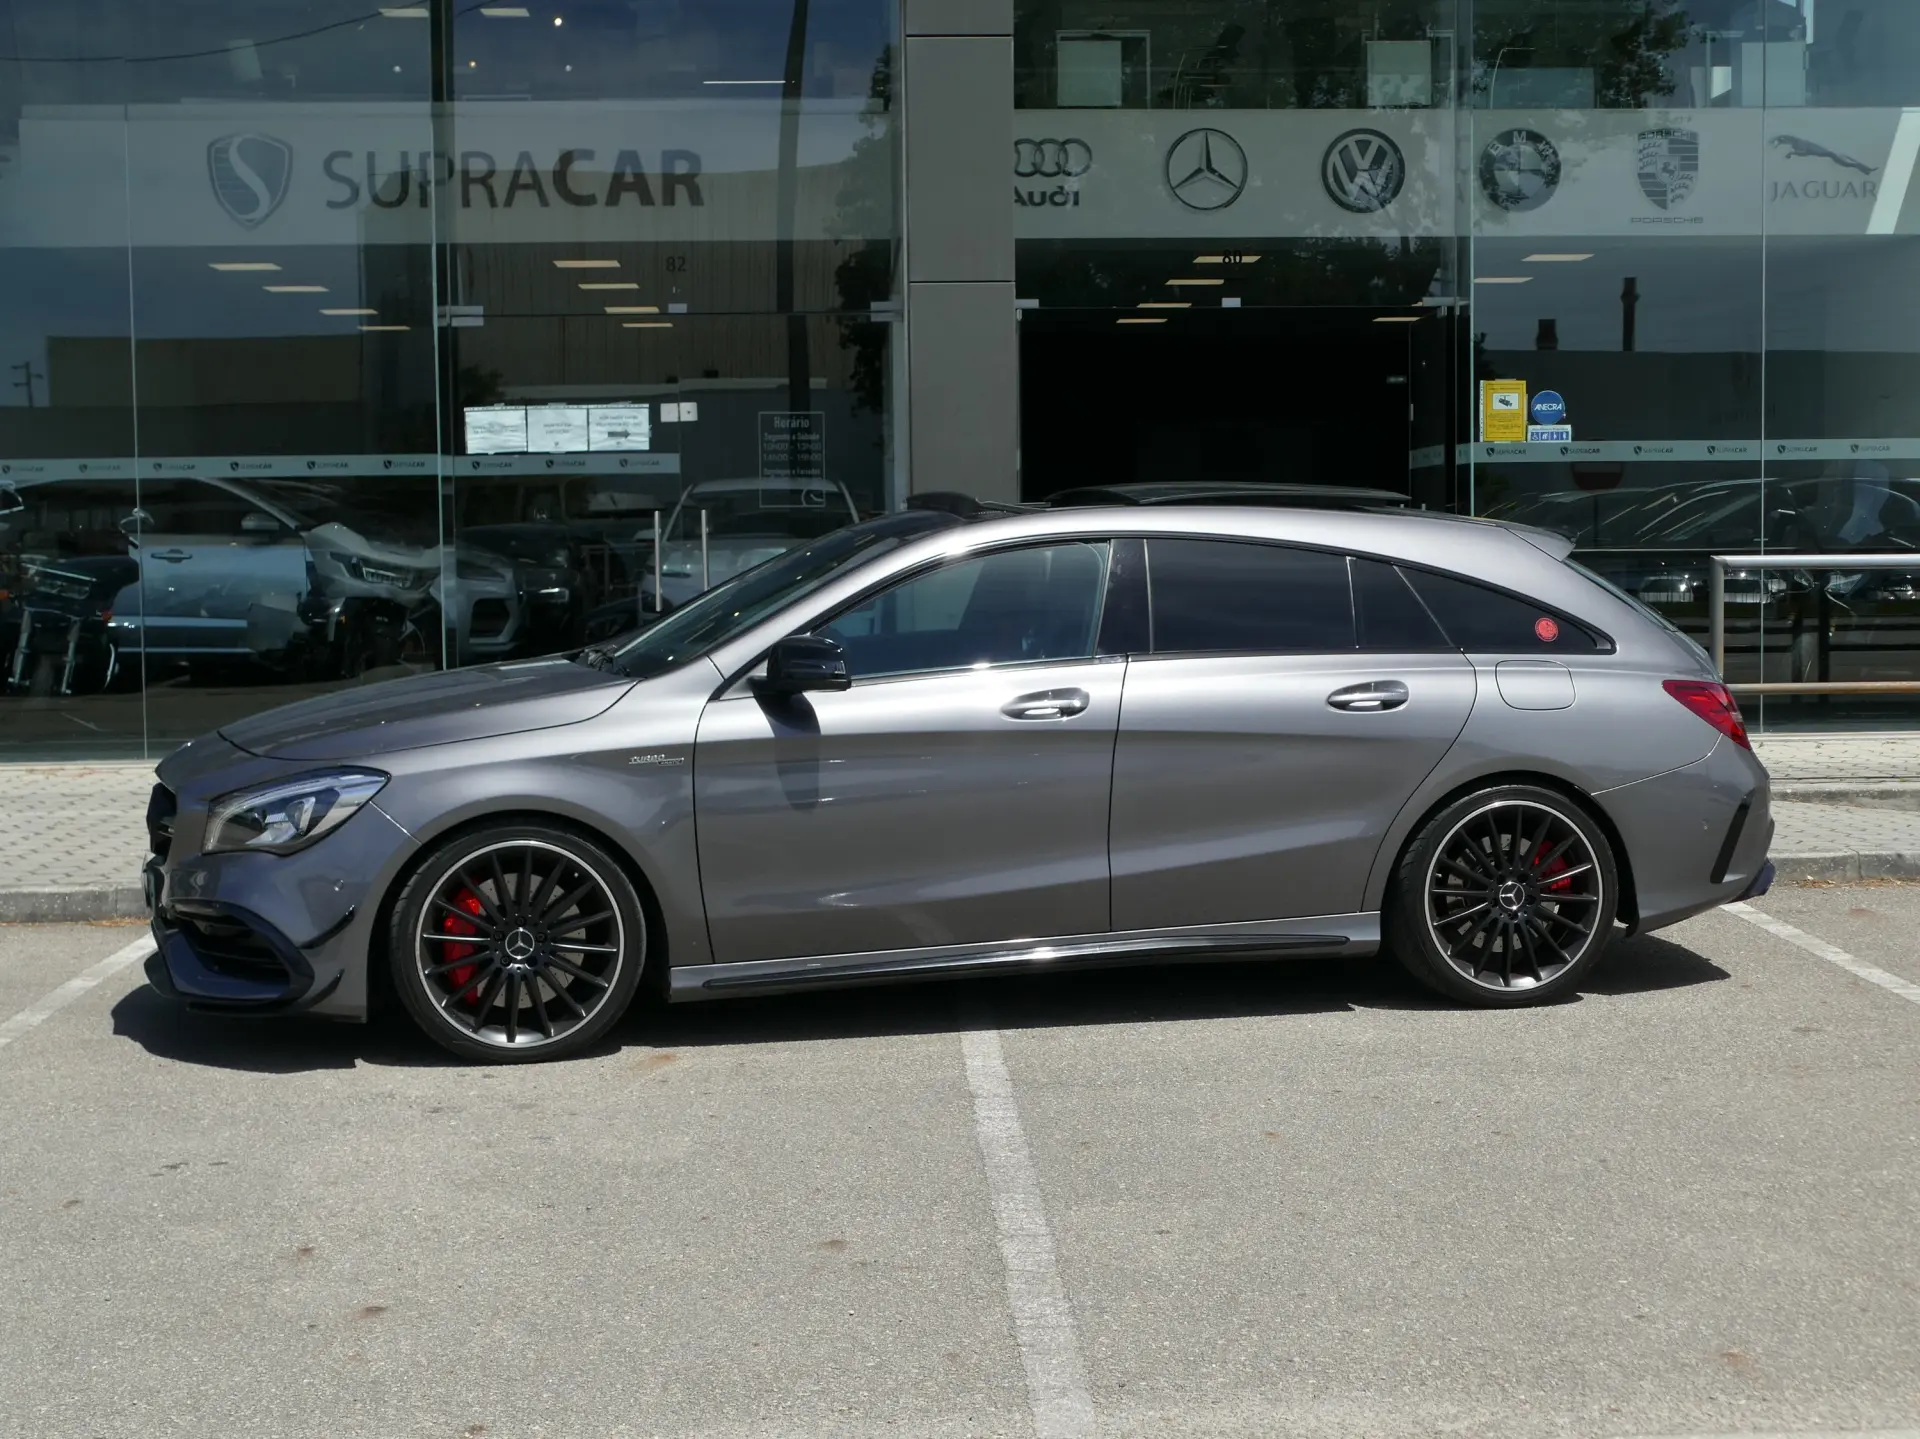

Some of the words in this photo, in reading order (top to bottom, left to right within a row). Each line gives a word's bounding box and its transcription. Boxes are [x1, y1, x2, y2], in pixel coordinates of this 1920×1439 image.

[322, 148, 705, 209] SUPRACAR
[1769, 179, 1877, 202] JAGUAR
[1630, 216, 1704, 225] PORSCHE
[665, 255, 687, 272] 82
[1222, 249, 1243, 264] 80
[1533, 403, 1563, 411] ANECRA
[773, 416, 810, 428] Horário
